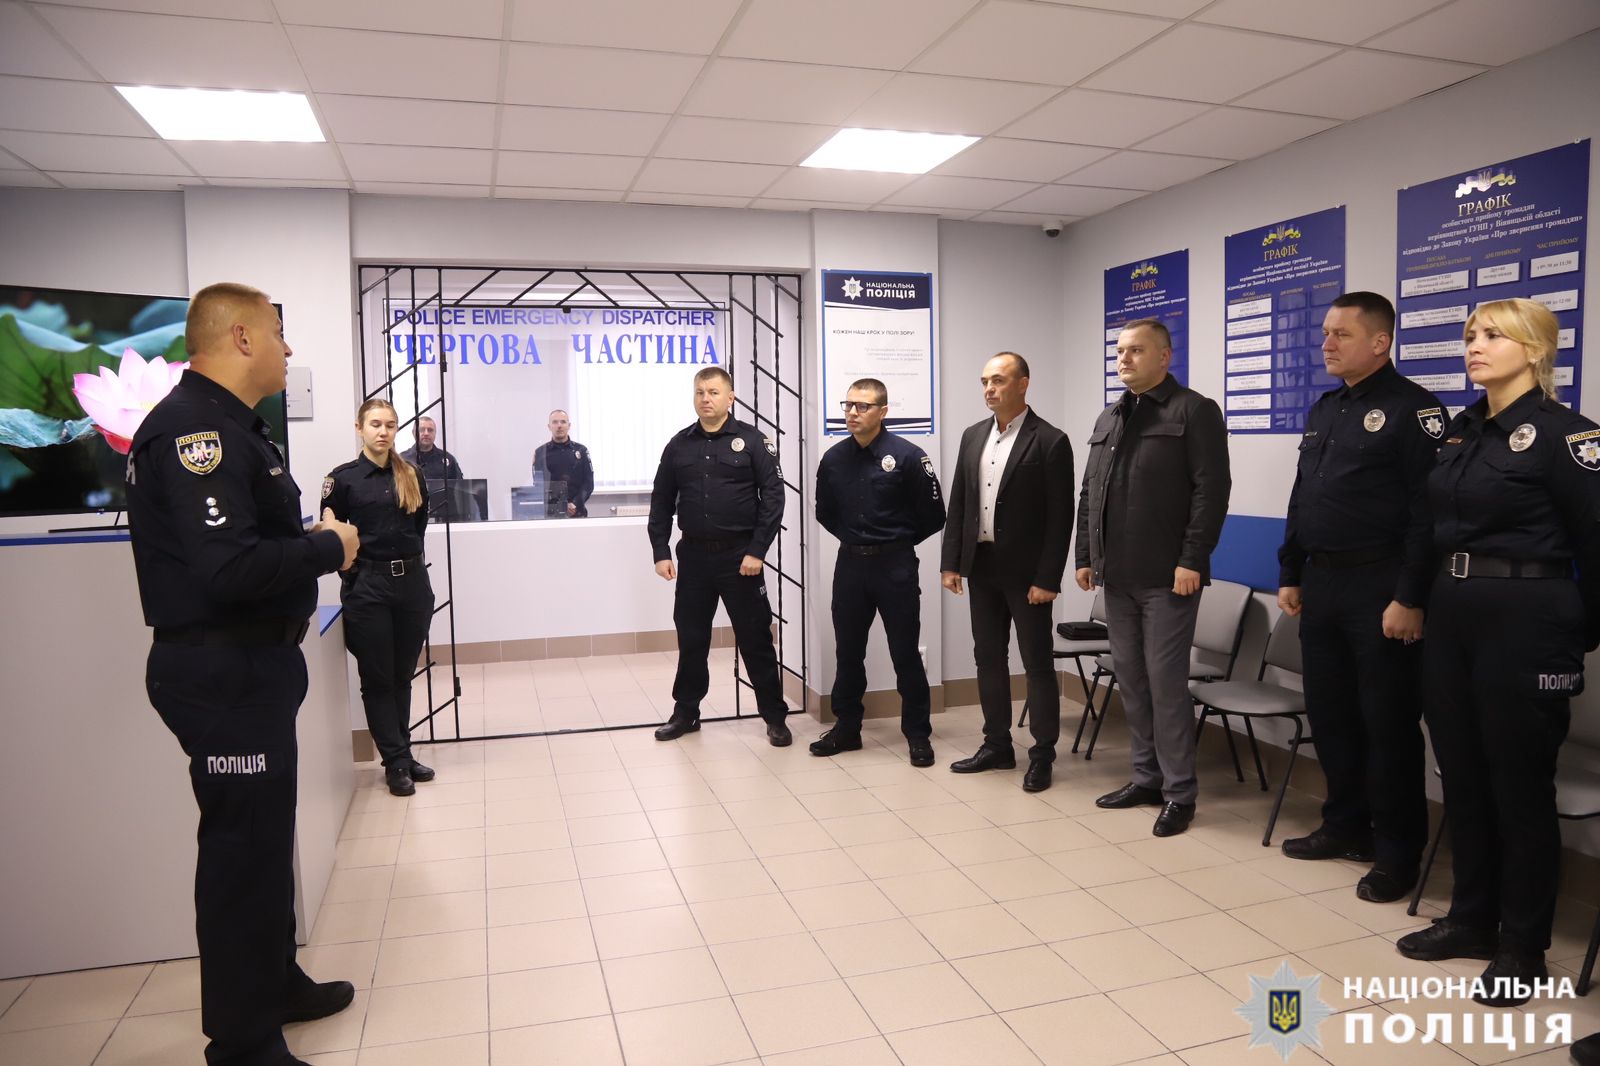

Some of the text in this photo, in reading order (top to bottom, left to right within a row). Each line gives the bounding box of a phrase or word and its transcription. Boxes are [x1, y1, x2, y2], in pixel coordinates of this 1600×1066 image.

[1458, 193, 1512, 217] ГРАФІК
[1264, 243, 1298, 261] ГРАФІК
[866, 289, 916, 299] ПОЛІЦІЯ
[1132, 279, 1157, 292] ГРАФІК
[394, 309, 716, 326] POLICE EMERGENCY DISPATCHER
[392, 333, 720, 364] ЧЕРГОВА ЧАСТИНА
[207, 753, 266, 774] ПОЛІЦІЯ
